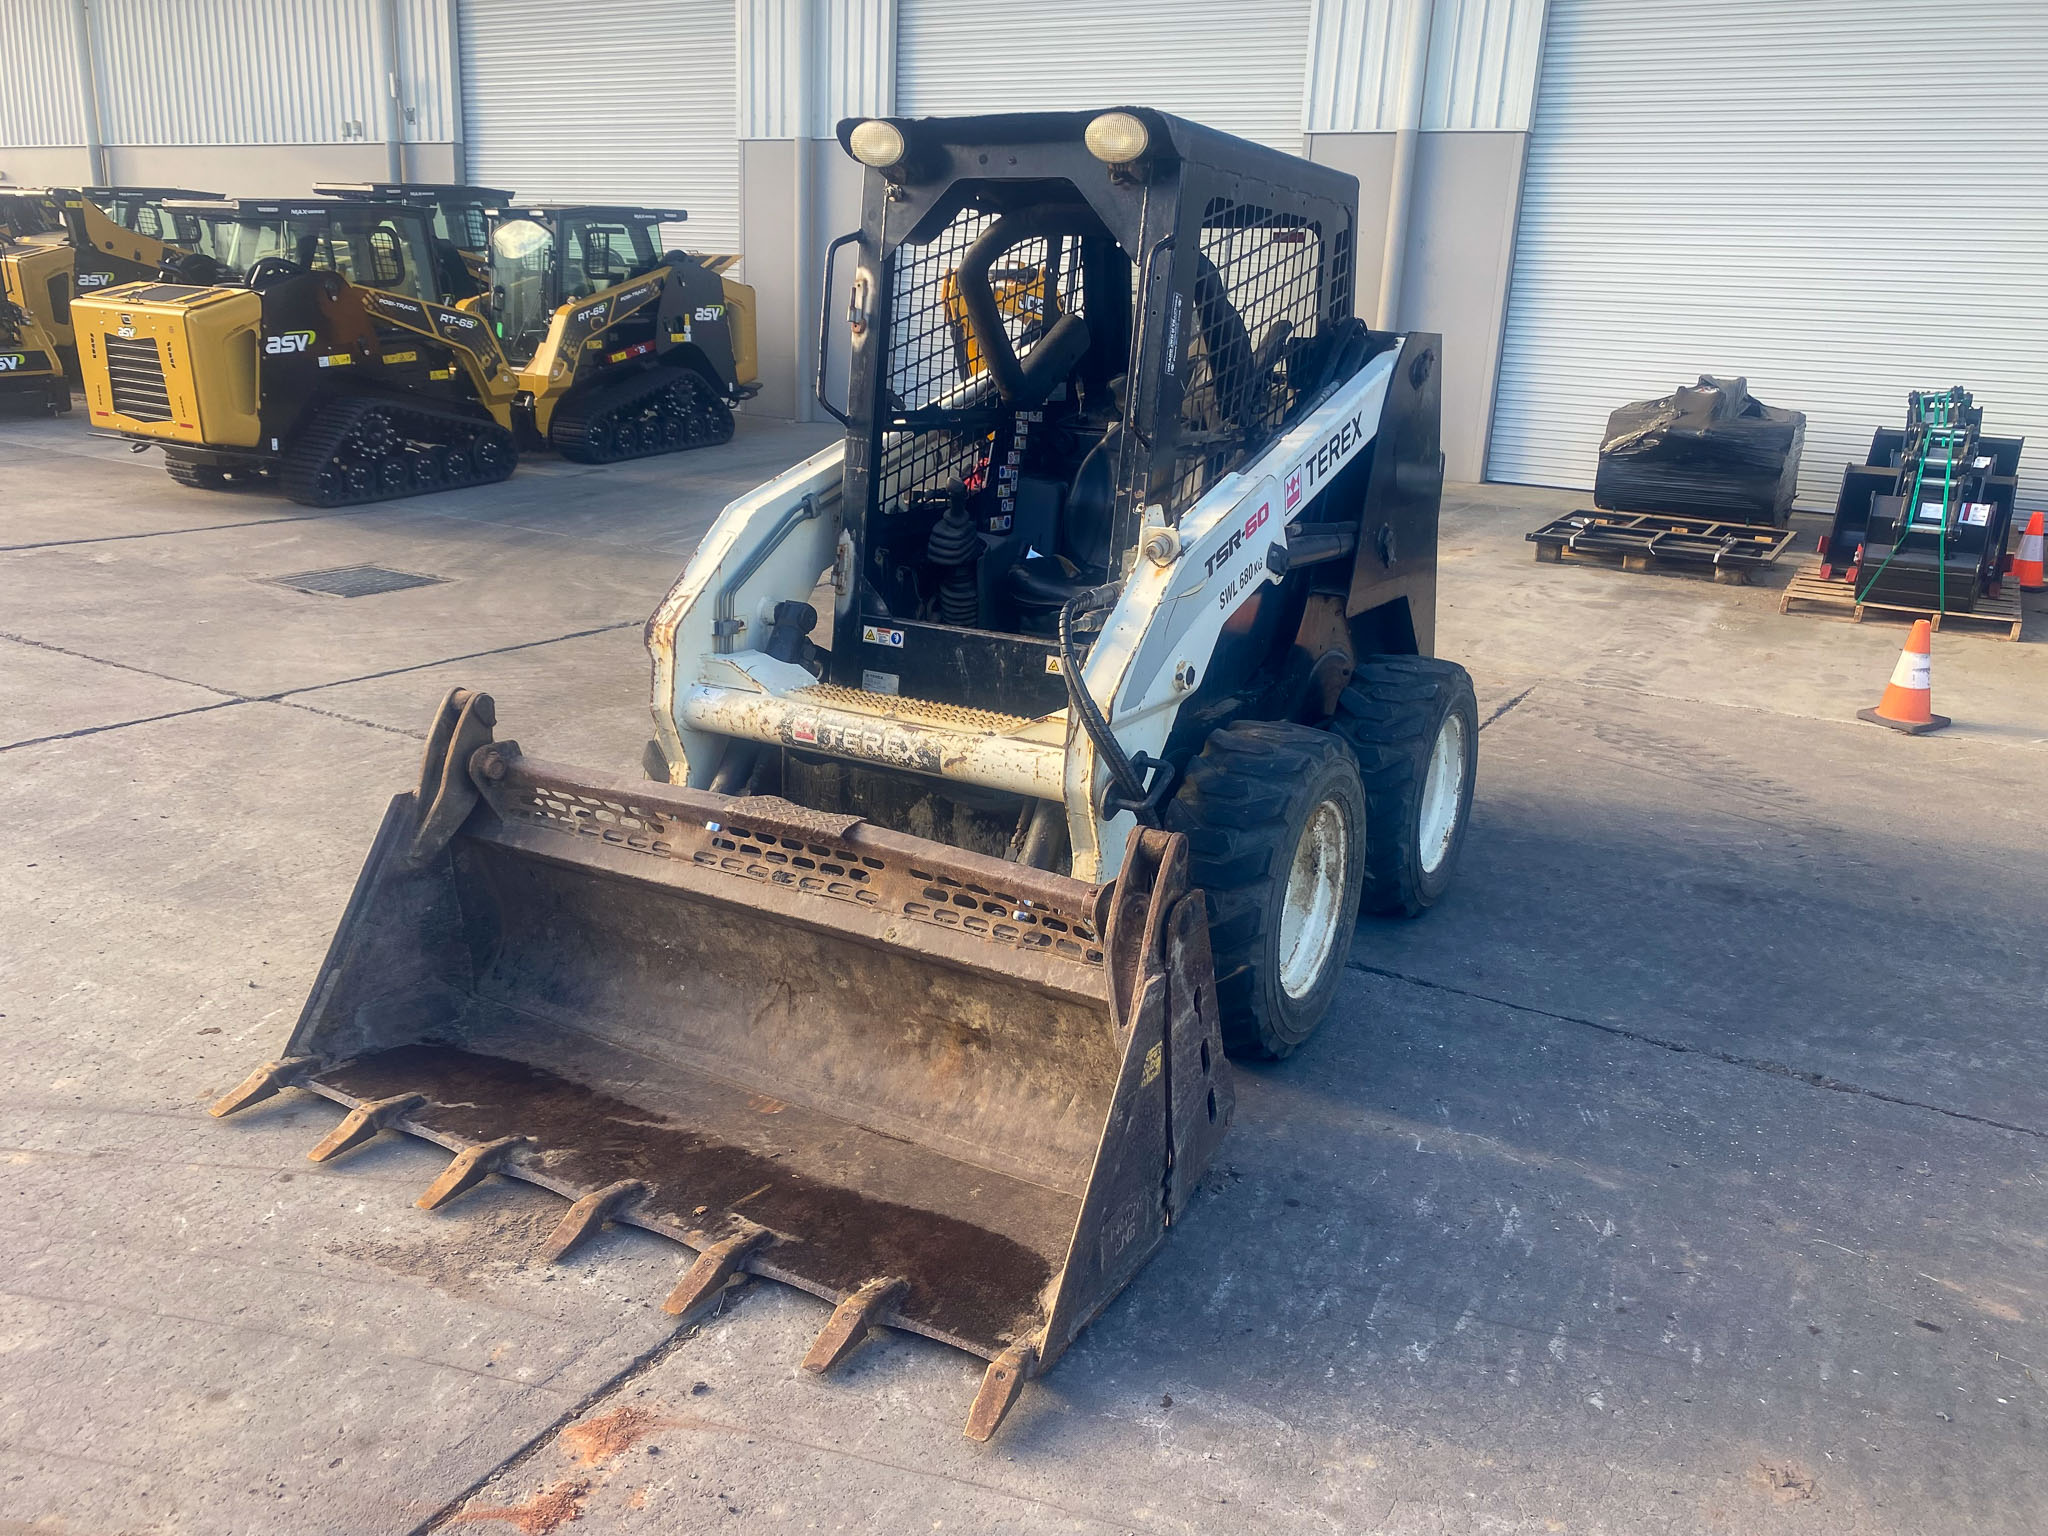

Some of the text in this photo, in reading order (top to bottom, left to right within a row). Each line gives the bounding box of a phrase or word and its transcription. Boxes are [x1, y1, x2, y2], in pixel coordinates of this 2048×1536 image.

[440, 313, 475, 329] RT-65
[578, 304, 606, 322] RT-65
[265, 334, 309, 354] asv
[1305, 409, 1362, 487] TEREX
[1204, 502, 1269, 578] TSR-60
[1220, 580, 1238, 610] SWL
[823, 724, 922, 762] TEREX
